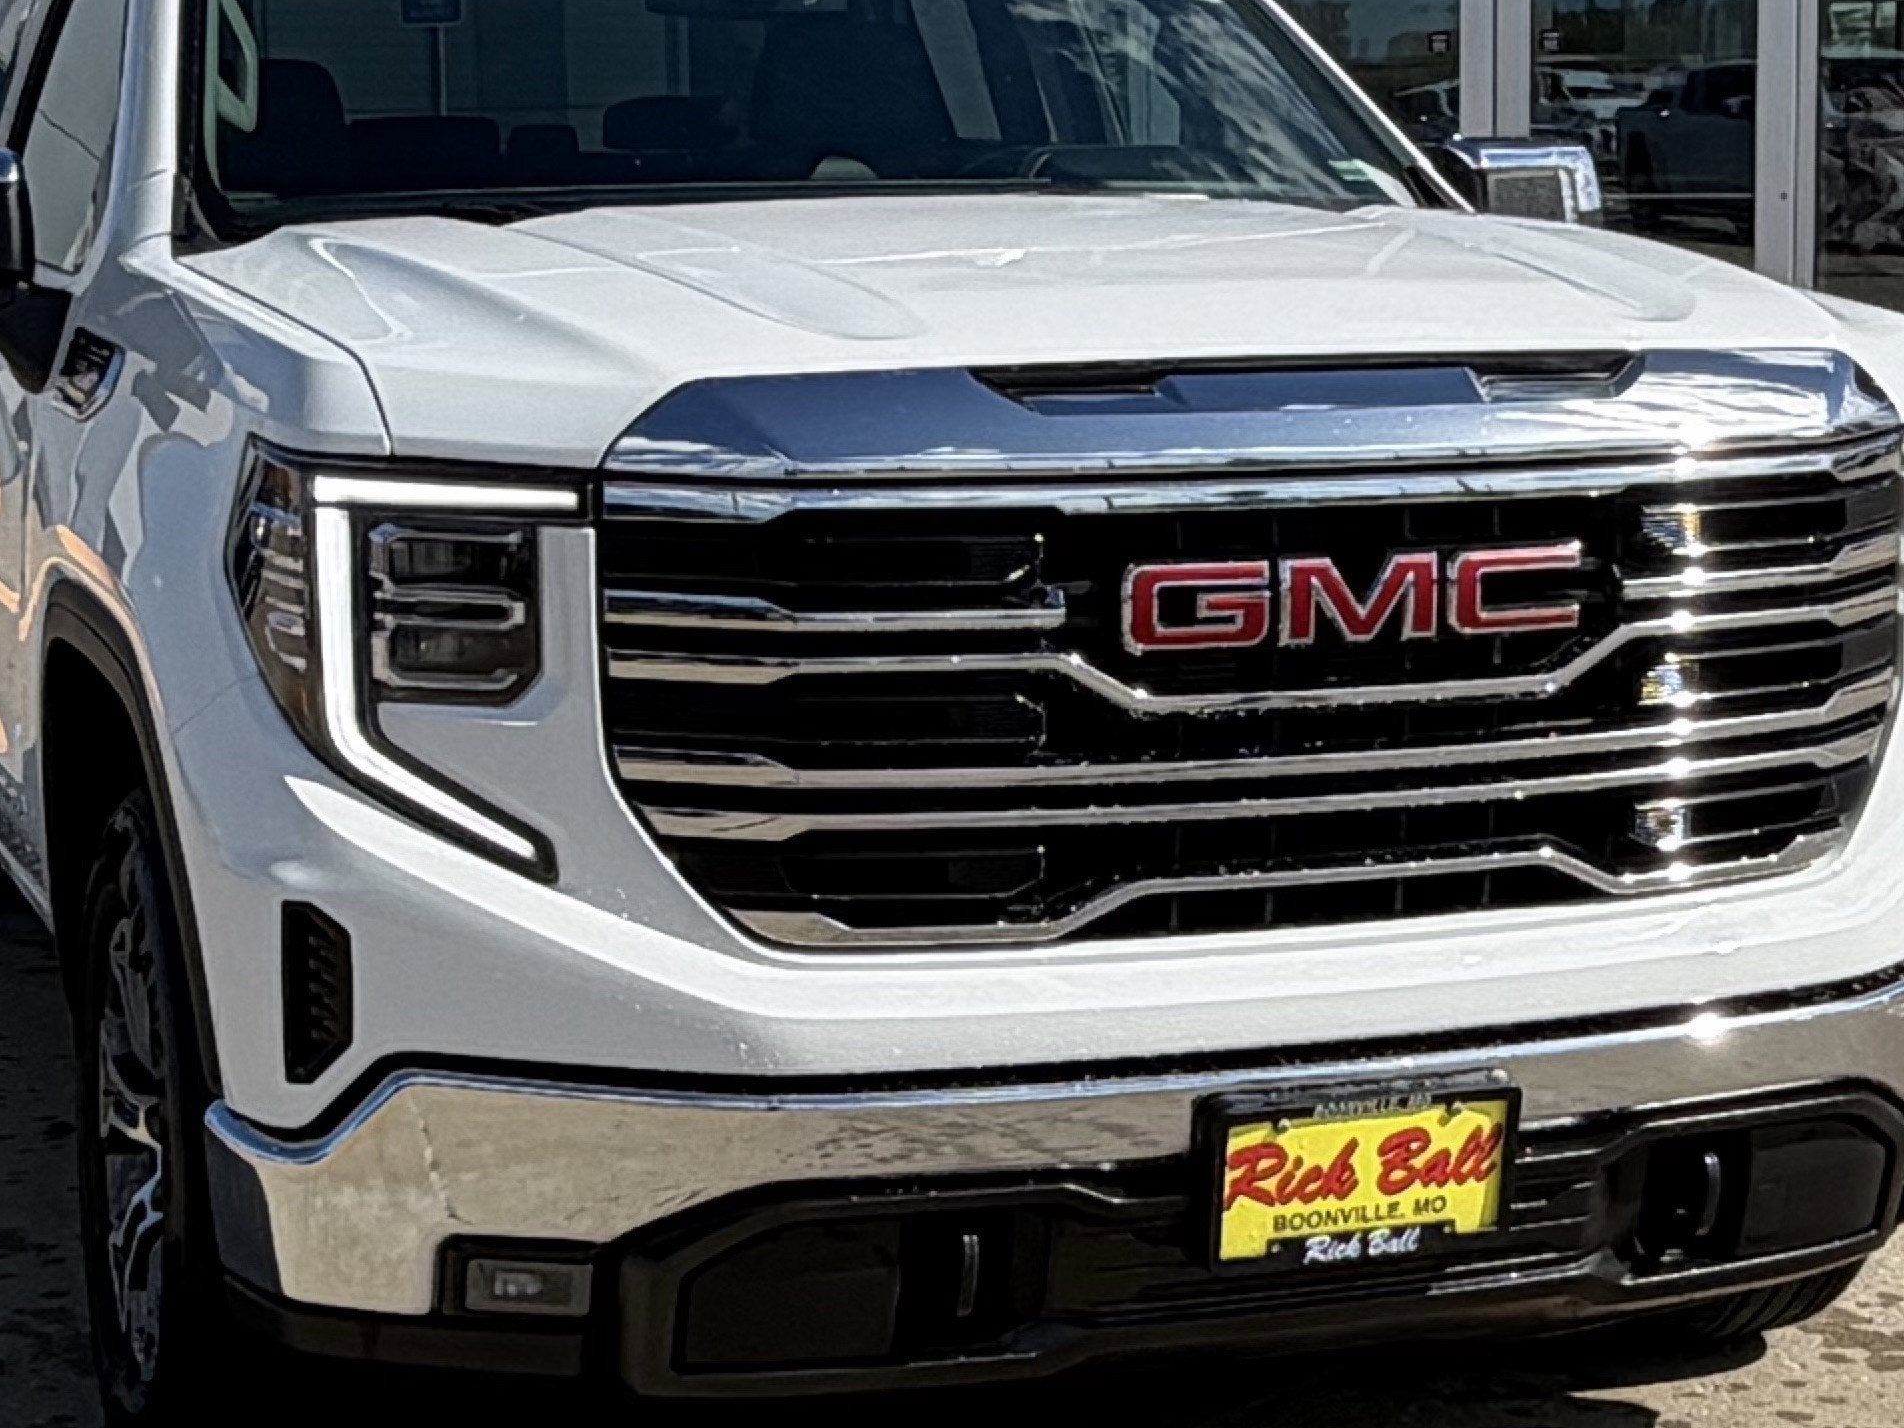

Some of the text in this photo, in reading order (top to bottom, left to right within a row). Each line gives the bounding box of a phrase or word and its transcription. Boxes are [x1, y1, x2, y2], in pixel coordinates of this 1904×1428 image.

[1123, 539, 1582, 654] GMC
[1224, 1122, 1504, 1211] Rick Ball
[1272, 1194, 1448, 1233] BOONVILLE, MO
[1302, 1226, 1421, 1265] Rick Ball
